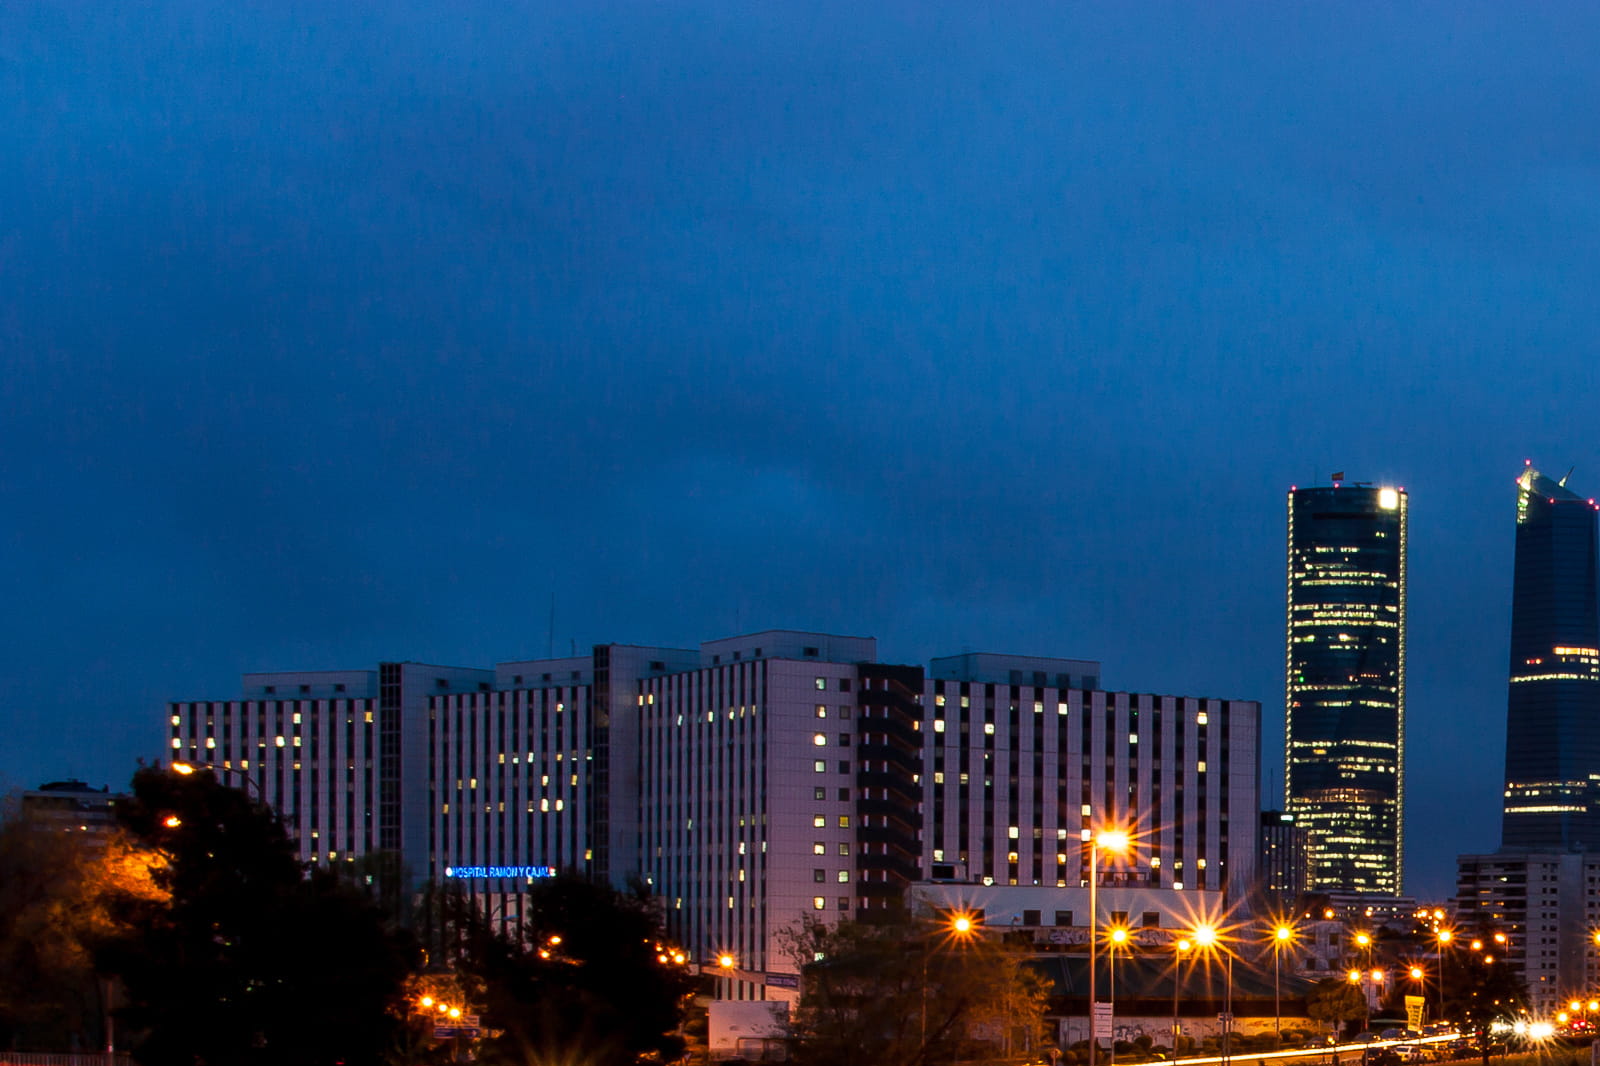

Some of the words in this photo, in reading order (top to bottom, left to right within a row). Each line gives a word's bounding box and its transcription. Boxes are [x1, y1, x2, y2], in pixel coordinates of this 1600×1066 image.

[453, 866, 488, 878] HOSPITAL
[518, 866, 525, 878] Y
[525, 866, 550, 878] CAJAL
